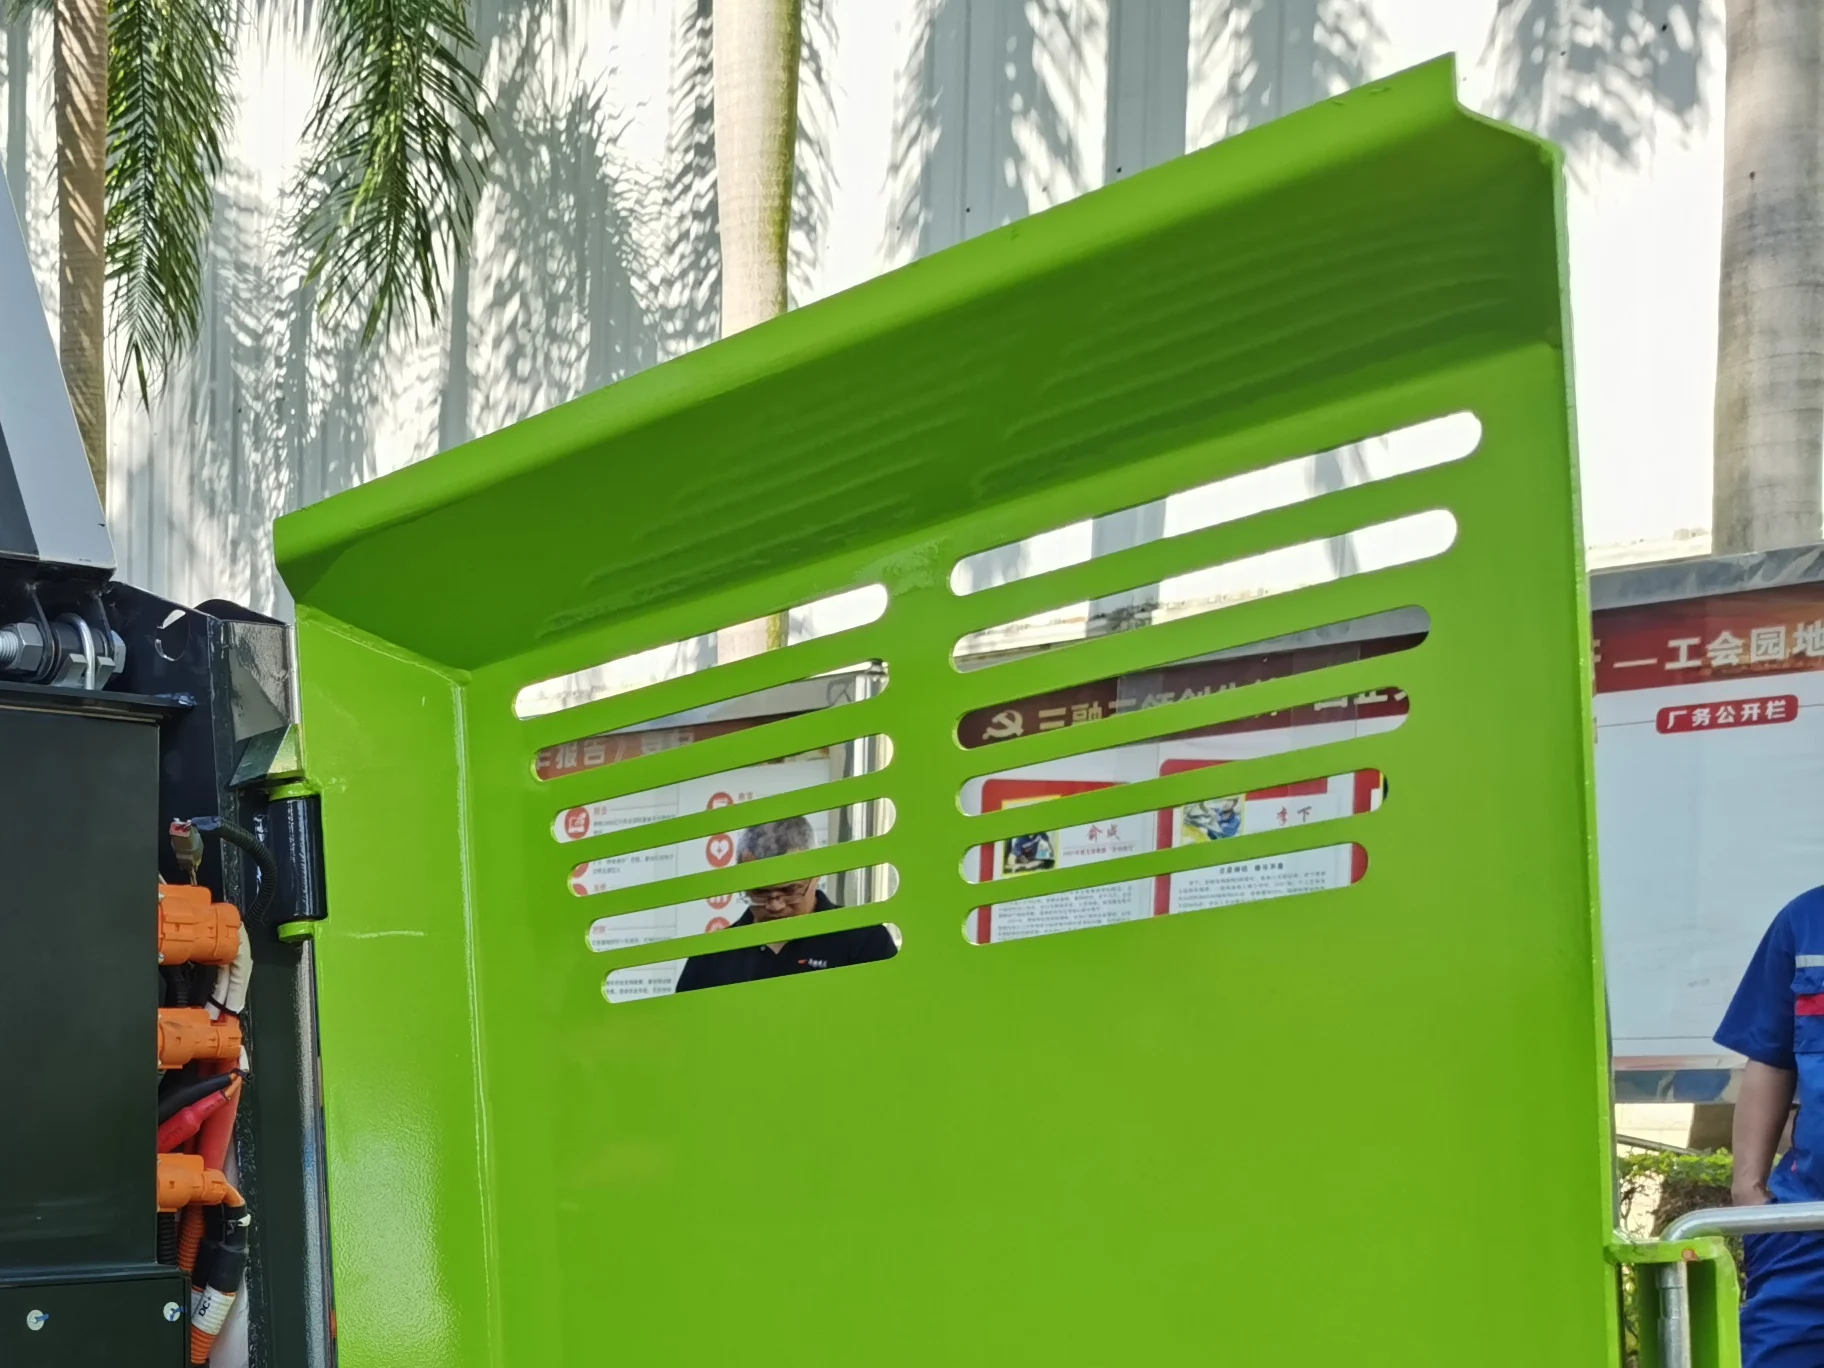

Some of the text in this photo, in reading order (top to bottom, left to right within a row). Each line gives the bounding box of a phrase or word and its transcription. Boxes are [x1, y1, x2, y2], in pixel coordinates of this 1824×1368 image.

[1666, 699, 1787, 730] 厂务公开栏
[198, 1295, 213, 1317] DC+
